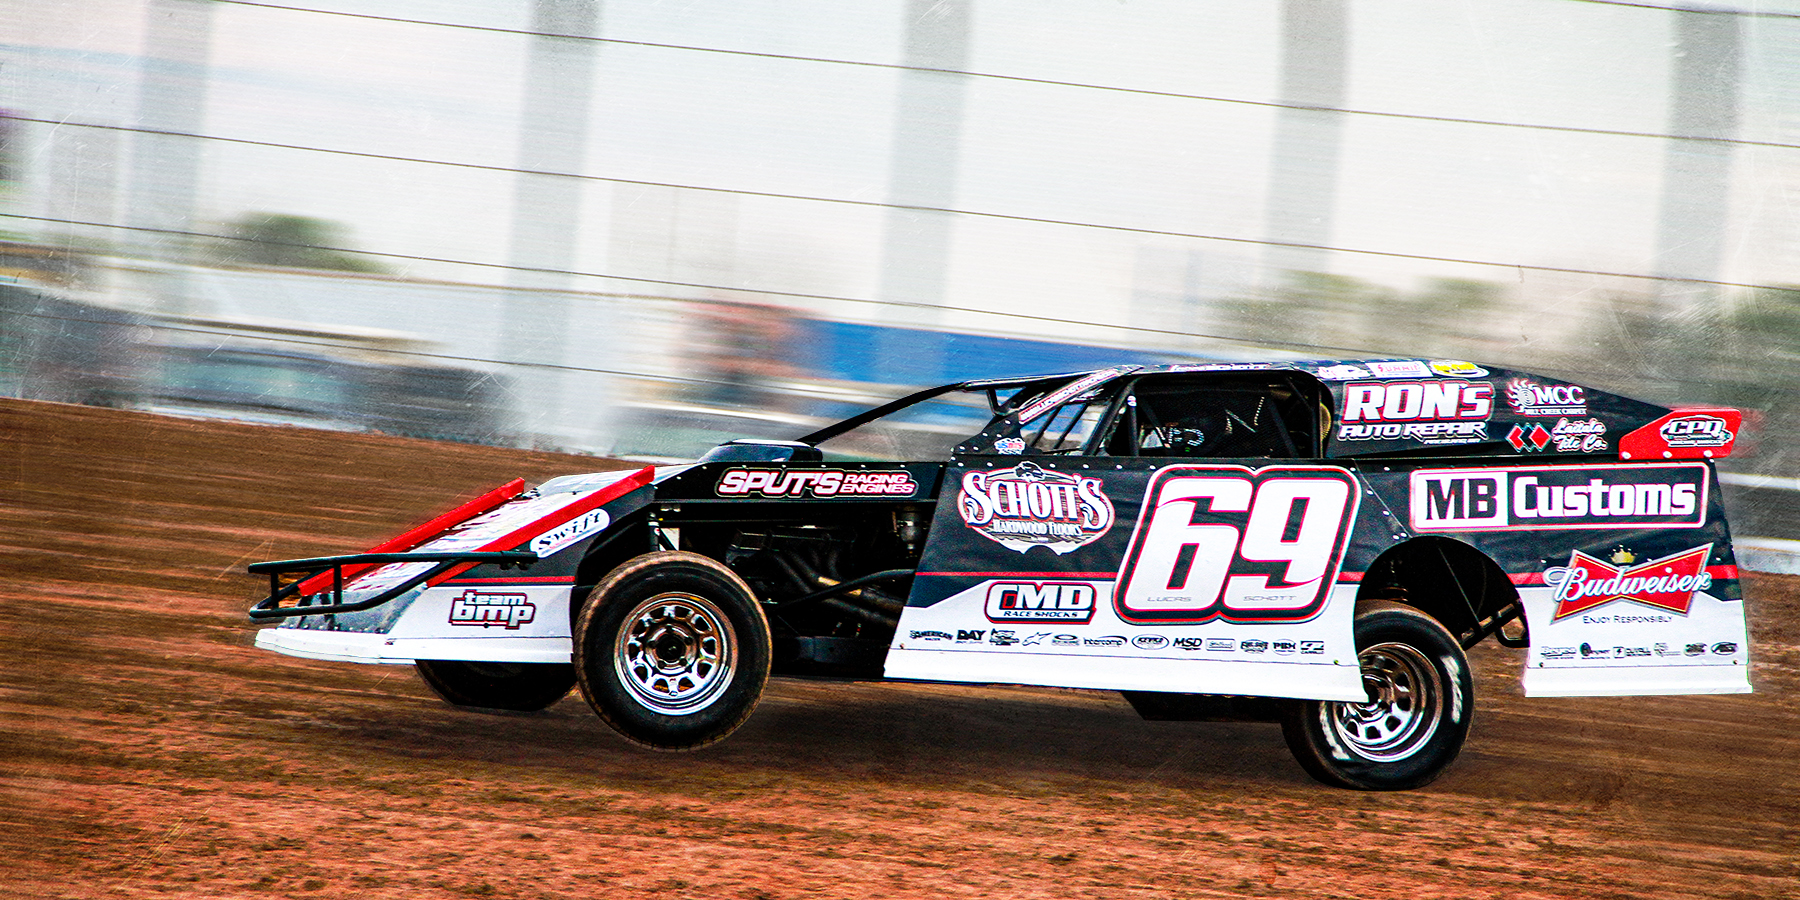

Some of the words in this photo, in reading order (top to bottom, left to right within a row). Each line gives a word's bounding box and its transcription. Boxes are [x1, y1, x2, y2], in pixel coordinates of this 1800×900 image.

[1533, 385, 1586, 405] MCC
[1339, 424, 1401, 438] AUTO
[1403, 422, 1489, 441] REPAIR
[718, 471, 844, 494] SPUT'S
[844, 474, 909, 484] RACING
[840, 484, 915, 494] ENGINES
[1425, 478, 1498, 520] MB
[1513, 475, 1697, 518] Customs
[538, 512, 601, 551] Swift
[1125, 476, 1350, 611] 69
[1543, 565, 1712, 602] Budweiser
[464, 591, 526, 605] team
[1147, 595, 1192, 603] LUCAS
[451, 600, 535, 627] bmp
[956, 629, 987, 640] DAY
[1172, 637, 1203, 647] MSD
